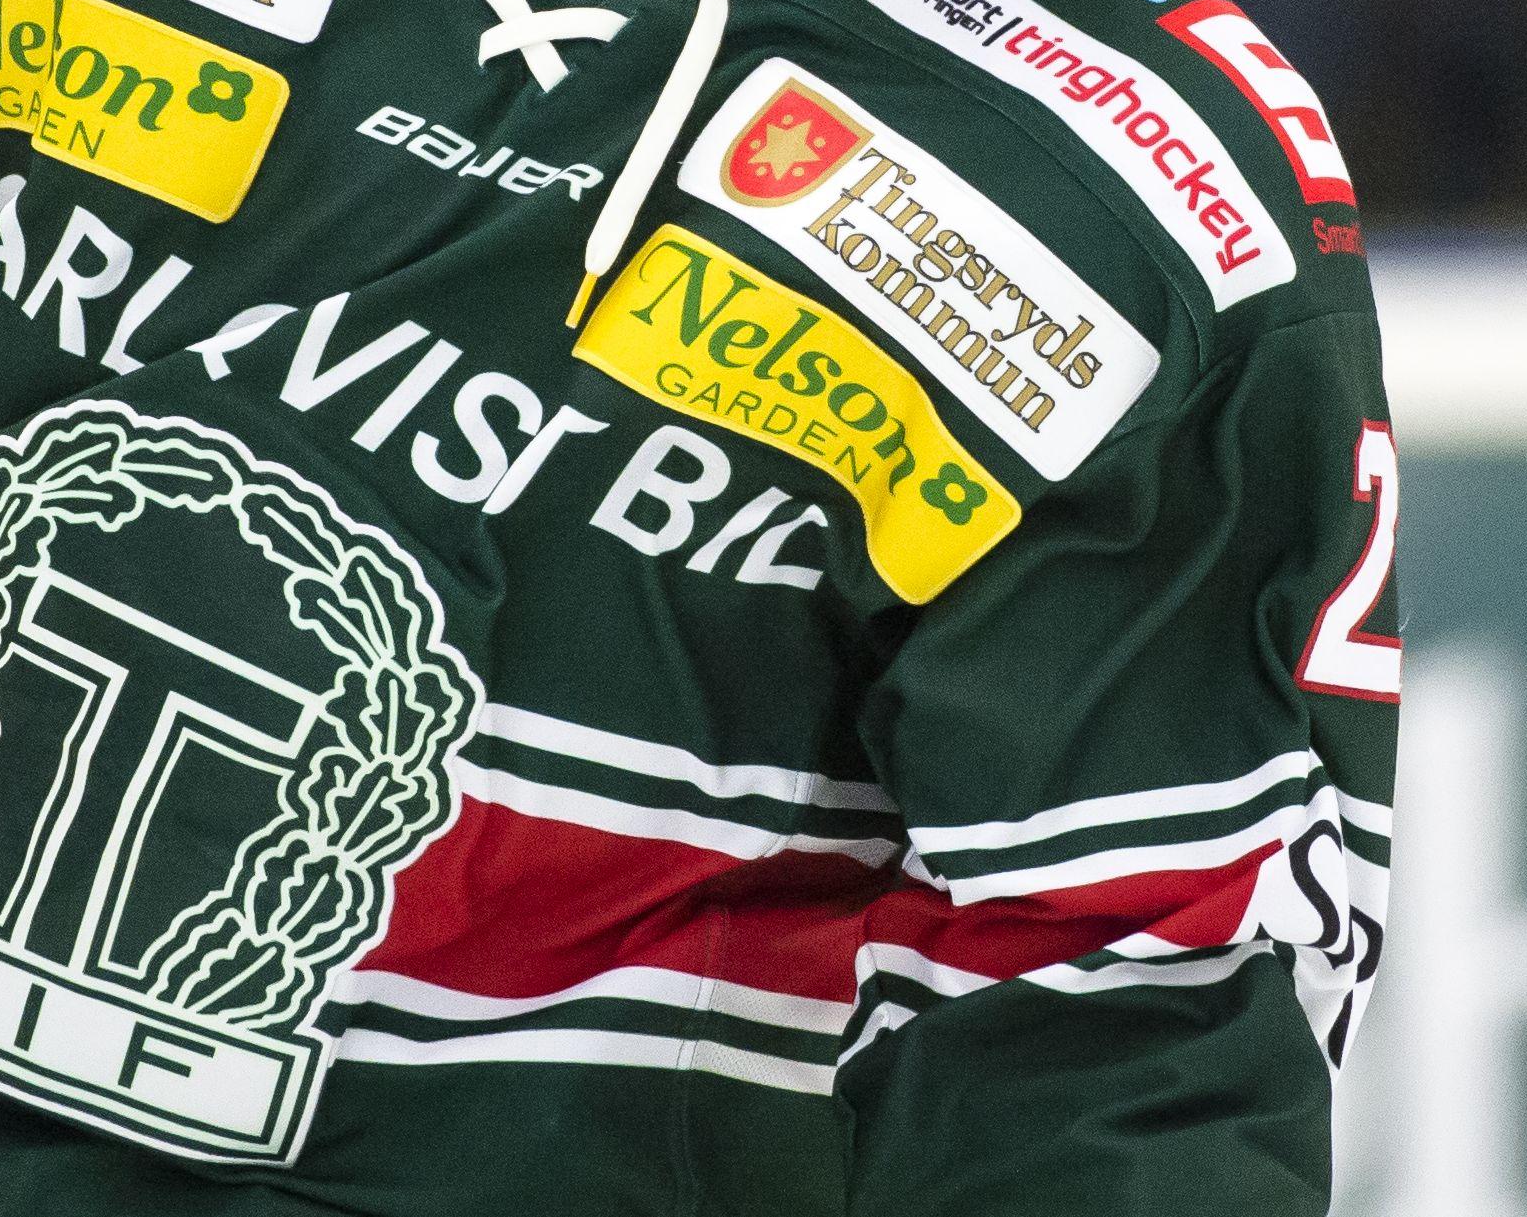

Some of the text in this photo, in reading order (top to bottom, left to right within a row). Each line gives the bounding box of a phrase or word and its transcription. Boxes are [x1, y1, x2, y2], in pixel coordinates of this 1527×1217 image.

[629, 239, 916, 495] Nelson
[803, 192, 1056, 434] kommun
[841, 147, 1103, 390] Tingsryds
[655, 362, 874, 484] GARDEN
